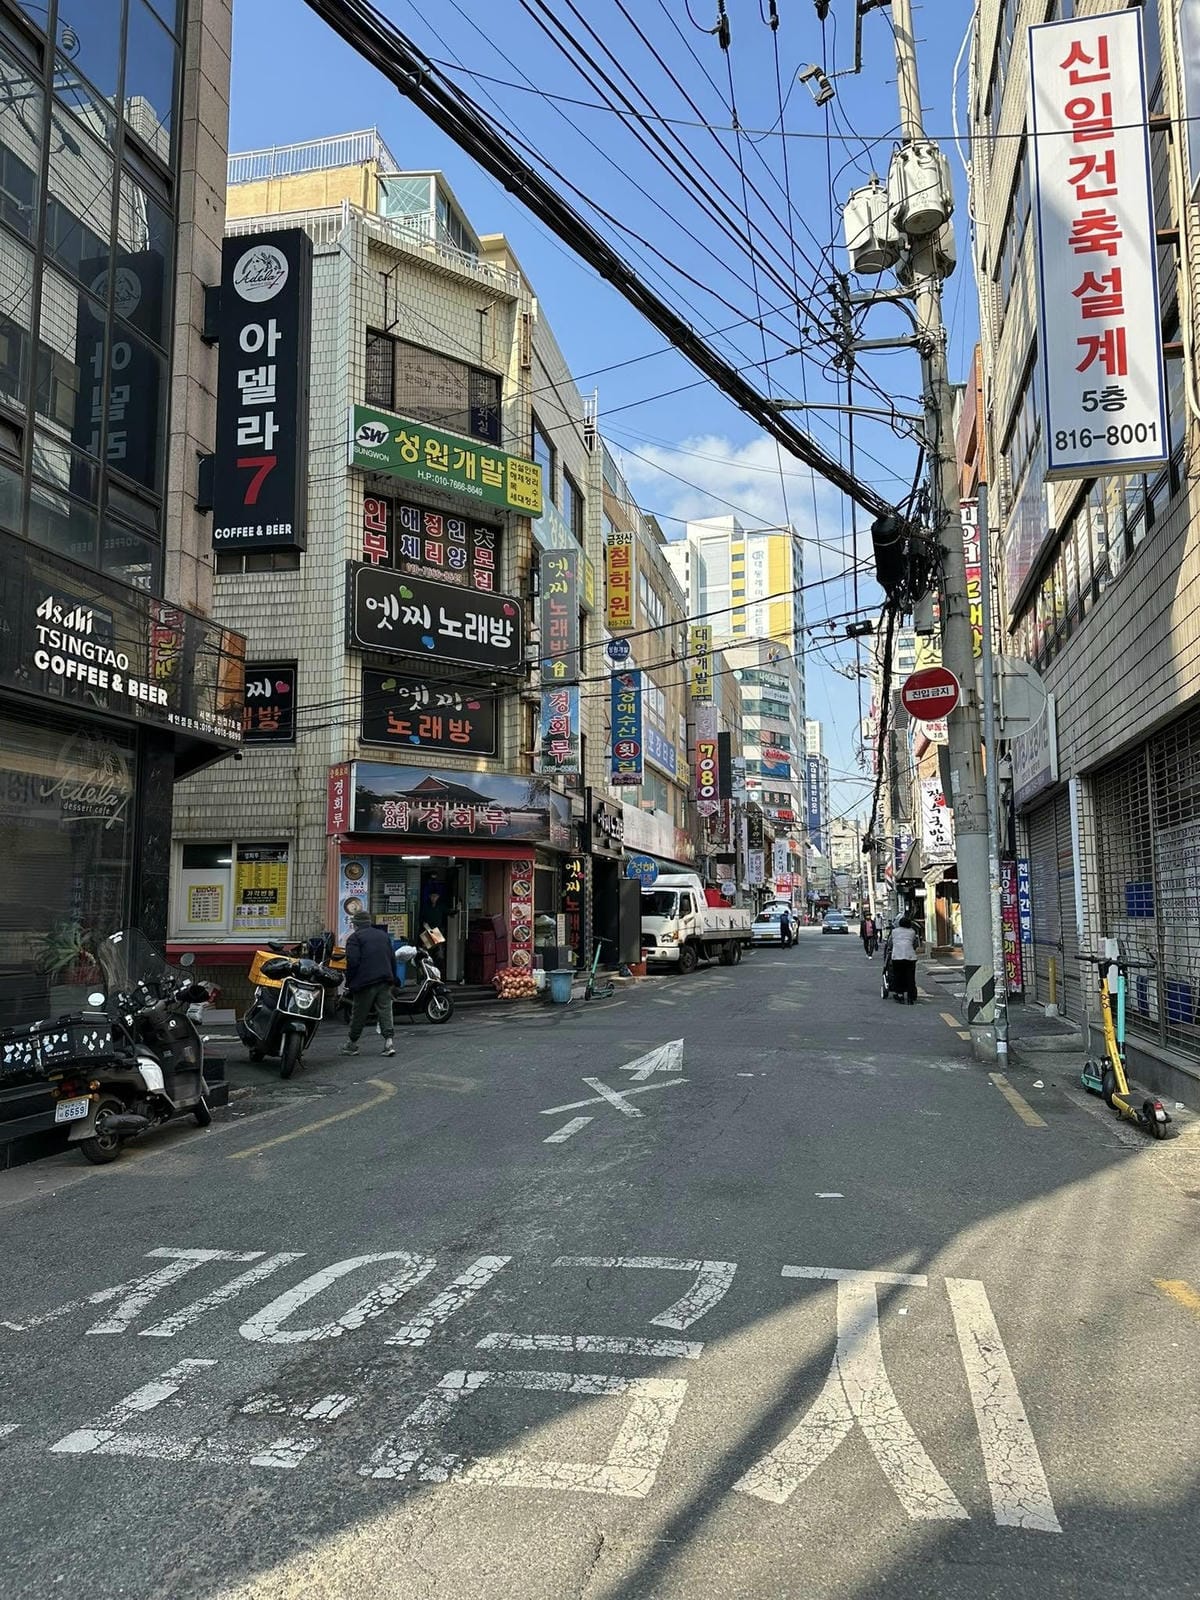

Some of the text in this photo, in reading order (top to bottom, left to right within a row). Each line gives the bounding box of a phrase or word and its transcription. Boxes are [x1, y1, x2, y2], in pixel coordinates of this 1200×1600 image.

[1059, 35, 1128, 377] 신일건축설계
[1081, 387, 1128, 413] 5층
[358, 425, 388, 444] SW
[1055, 422, 1158, 452] 816-8001
[395, 430, 505, 489] 성원개발
[214, 522, 292, 540] COFFEE & BEER
[363, 497, 389, 565] 인부
[609, 546, 630, 619] 철학원
[36, 596, 94, 635] Asahi
[437, 606, 514, 649] 노래방
[549, 598, 570, 659] 노래방
[36, 624, 129, 671] TSINGTAO
[34, 649, 169, 707] COFFEE & BEER
[695, 686, 709, 695] 3F
[911, 686, 950, 700] 진입금지
[386, 710, 473, 745] 노래방
[548, 690, 574, 764] 경회루
[700, 744, 716, 798] 7080
[333, 779, 345, 829] 경회루
[417, 804, 509, 836] 경회루
